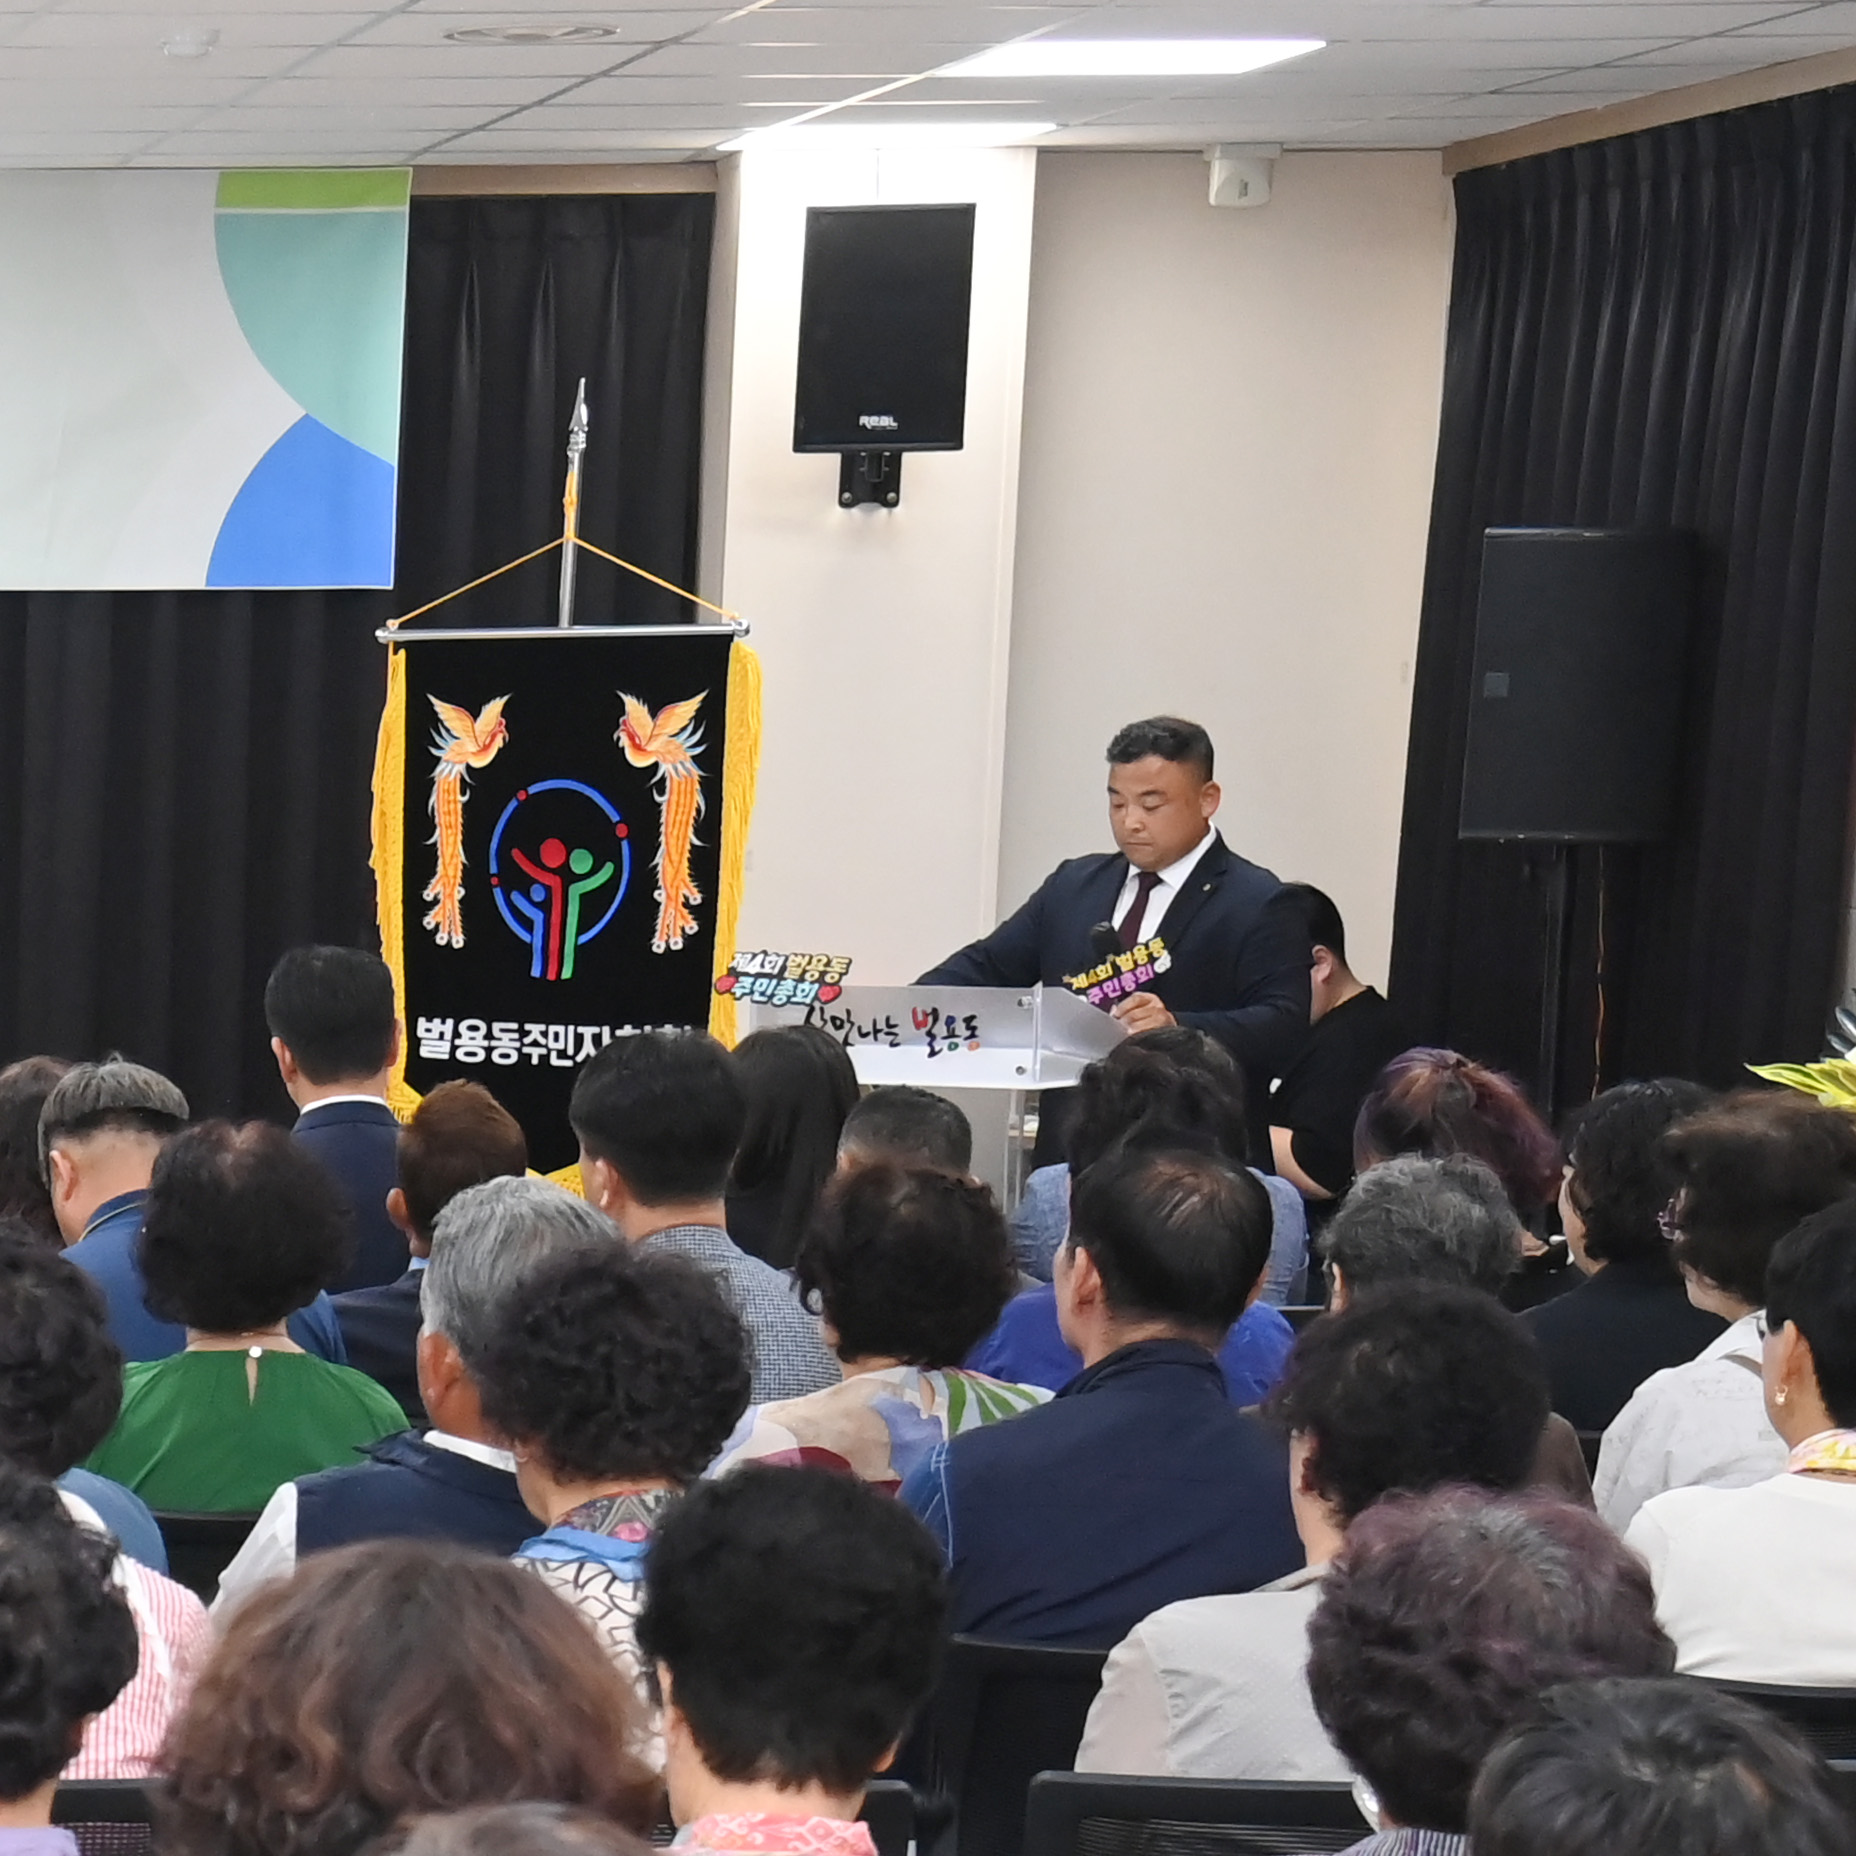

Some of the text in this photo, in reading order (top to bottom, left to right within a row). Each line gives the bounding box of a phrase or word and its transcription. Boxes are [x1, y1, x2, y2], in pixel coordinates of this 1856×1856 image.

[728, 952, 852, 980] 제4회 벌용동
[1115, 937, 1165, 973] 벌용동
[731, 977, 820, 1005] 주민총회
[1086, 963, 1155, 1004] 주민총회
[415, 1016, 692, 1068] 벌용동주민자
[911, 1006, 981, 1058] 벌용동
